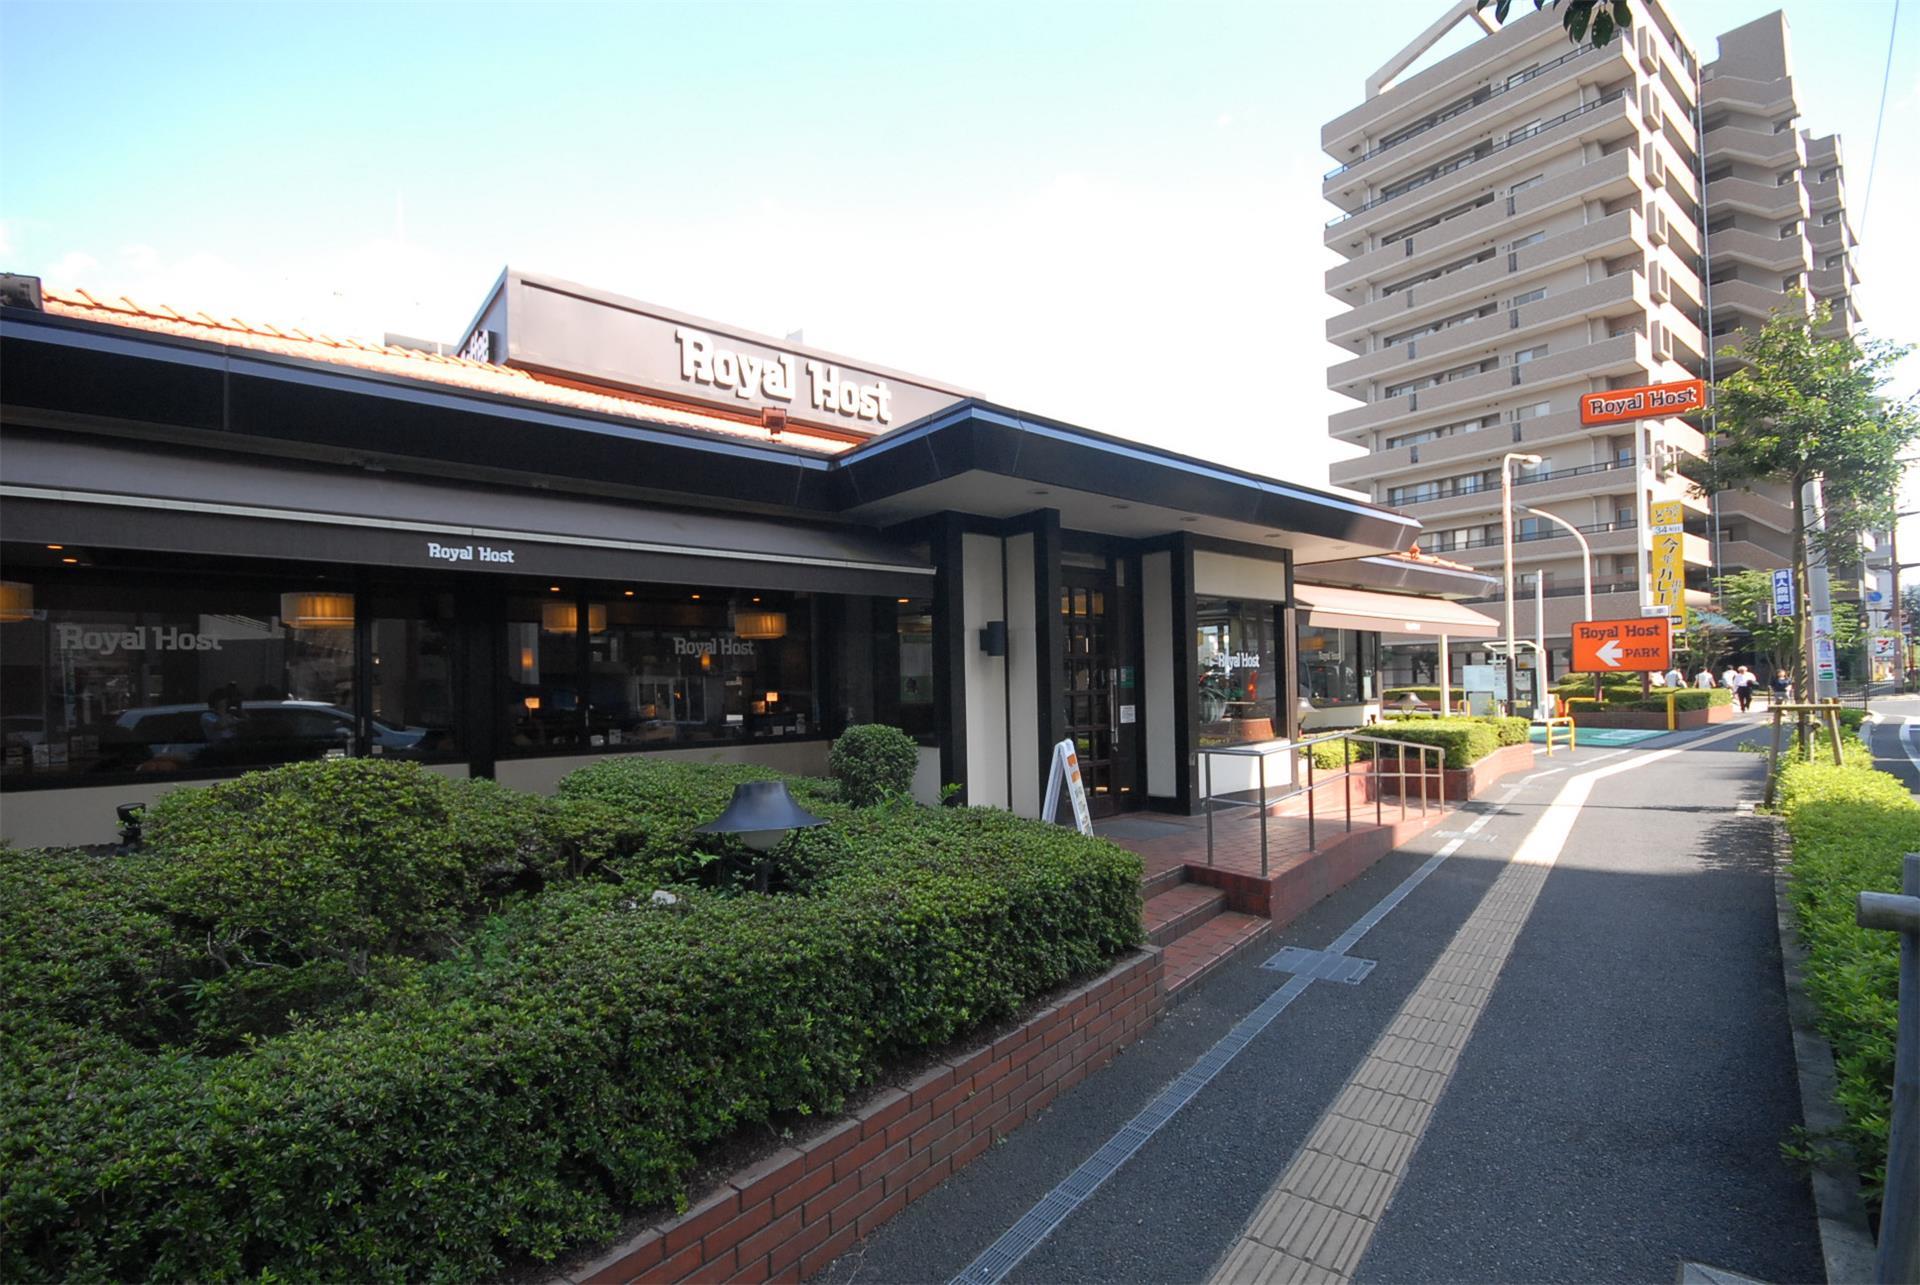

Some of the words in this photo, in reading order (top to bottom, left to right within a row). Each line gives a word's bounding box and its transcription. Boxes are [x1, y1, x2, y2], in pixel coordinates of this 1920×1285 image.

[676, 327, 796, 402] Royal
[806, 360, 893, 424] Host
[1589, 392, 1644, 415] Royal
[1648, 387, 1697, 407] Host
[427, 542, 473, 562] Royal
[477, 546, 515, 563] Host
[56, 622, 146, 655] Royal
[152, 626, 223, 650] Host
[1580, 625, 1619, 640] Royal
[1625, 624, 1660, 637] Host
[673, 637, 717, 658] Royal
[719, 638, 754, 655] Host
[1623, 648, 1660, 658] PARK
[1241, 652, 1260, 668] Host
